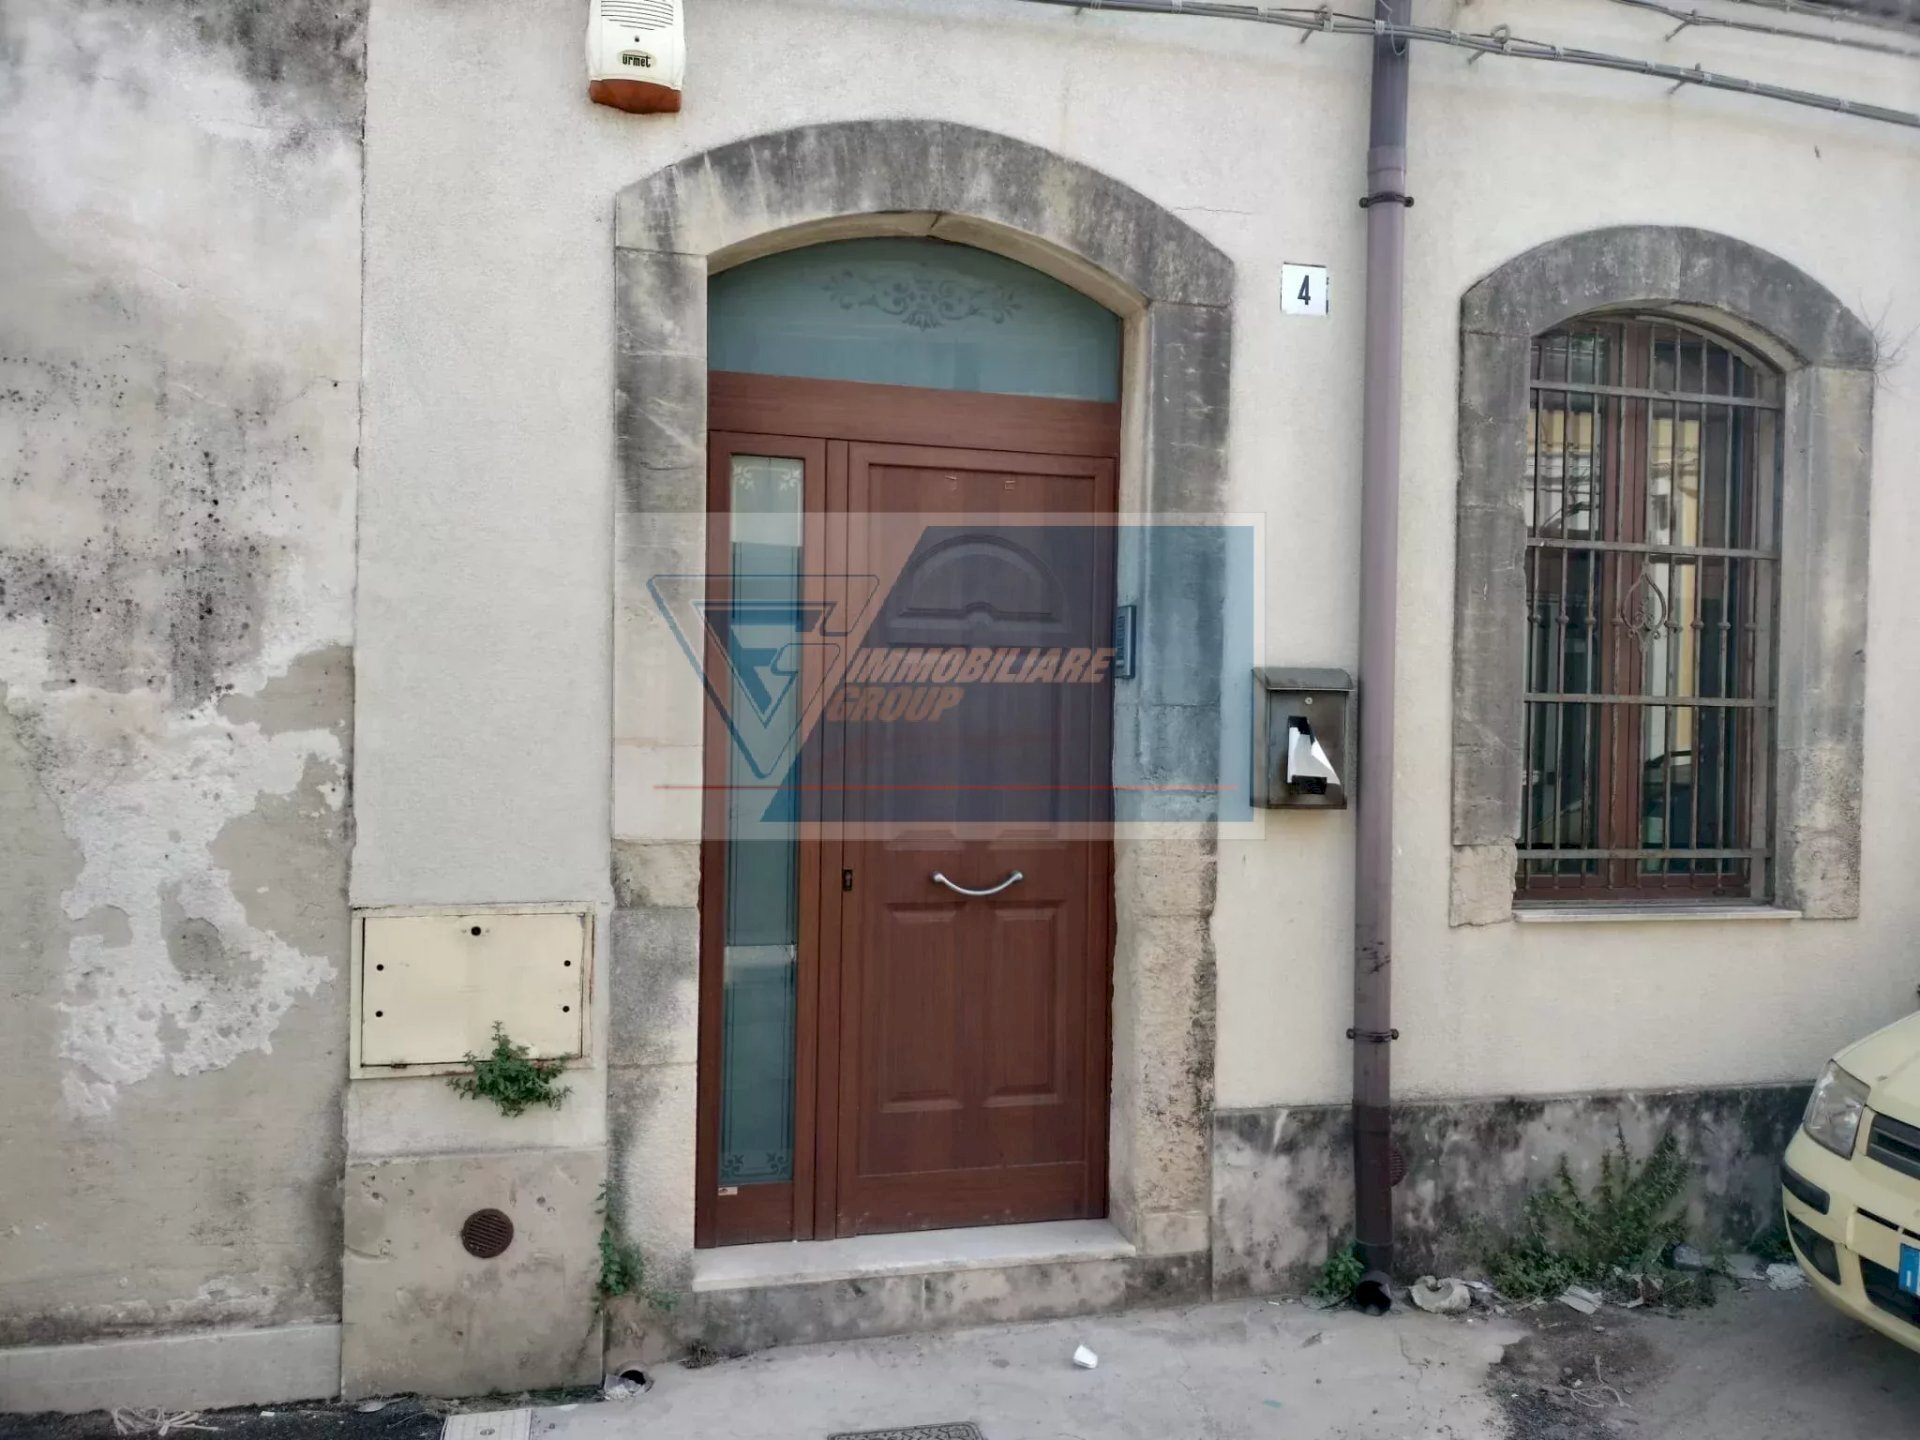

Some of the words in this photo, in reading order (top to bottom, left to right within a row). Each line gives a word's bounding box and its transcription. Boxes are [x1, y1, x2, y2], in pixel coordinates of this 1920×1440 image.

[622, 53, 651, 68] urmet
[1297, 274, 1311, 306] 4
[1905, 1270, 1912, 1287] I
